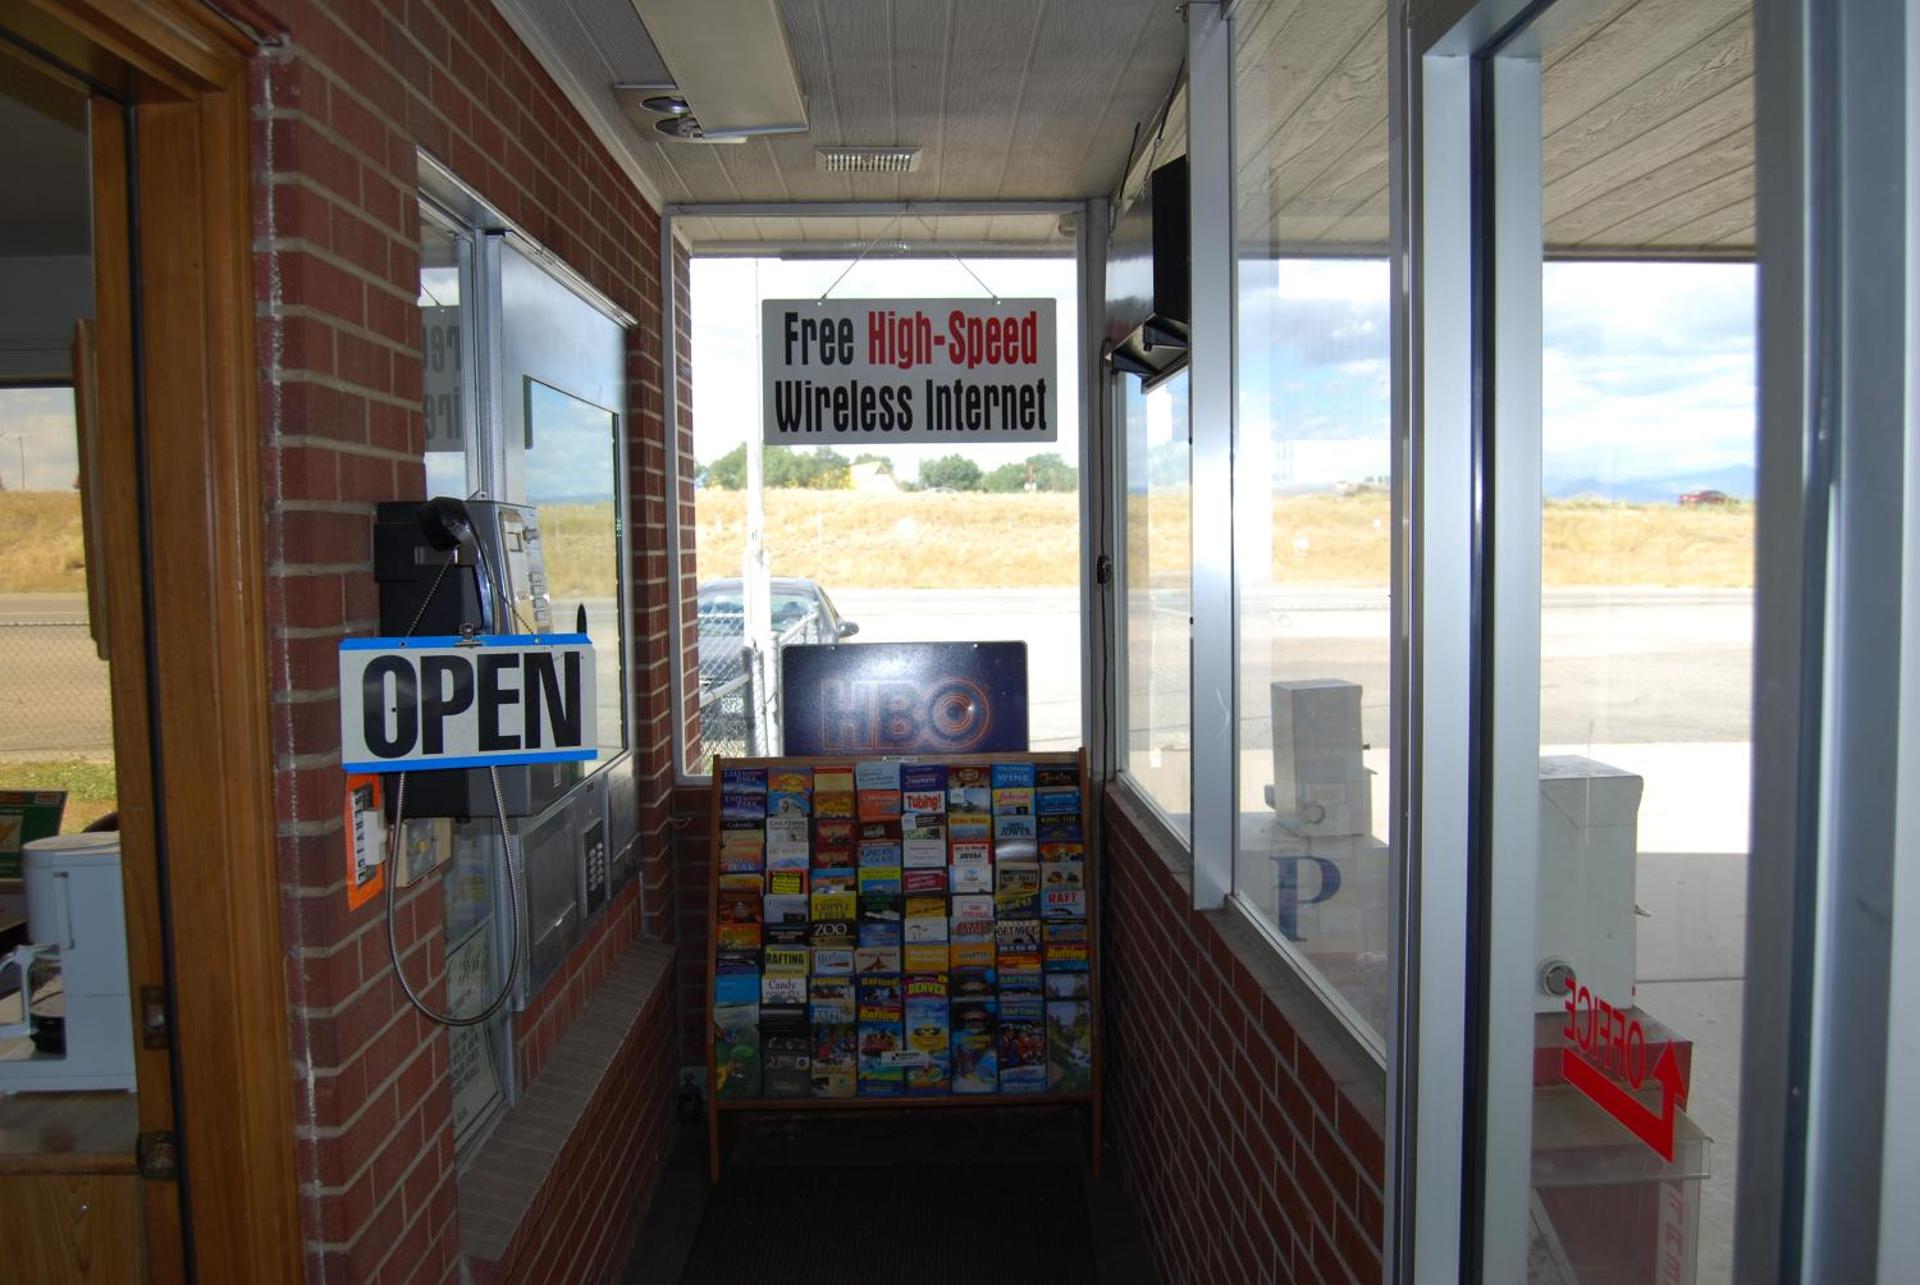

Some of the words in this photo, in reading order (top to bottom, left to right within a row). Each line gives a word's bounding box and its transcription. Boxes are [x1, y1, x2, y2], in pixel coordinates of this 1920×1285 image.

[785, 312, 854, 366] Free
[868, 310, 1037, 369] High-Speed
[775, 379, 913, 433] Wireless
[926, 378, 1047, 432] Internet
[363, 652, 582, 758] OPEN
[821, 677, 988, 750] HBO
[998, 773, 1030, 781] WINE
[907, 793, 942, 811] Tubing!
[1047, 892, 1077, 903] RAFT
[813, 922, 848, 936] ZOO
[767, 953, 805, 965] RAFTING
[769, 978, 797, 990] Candy
[908, 982, 947, 996] DENVER
